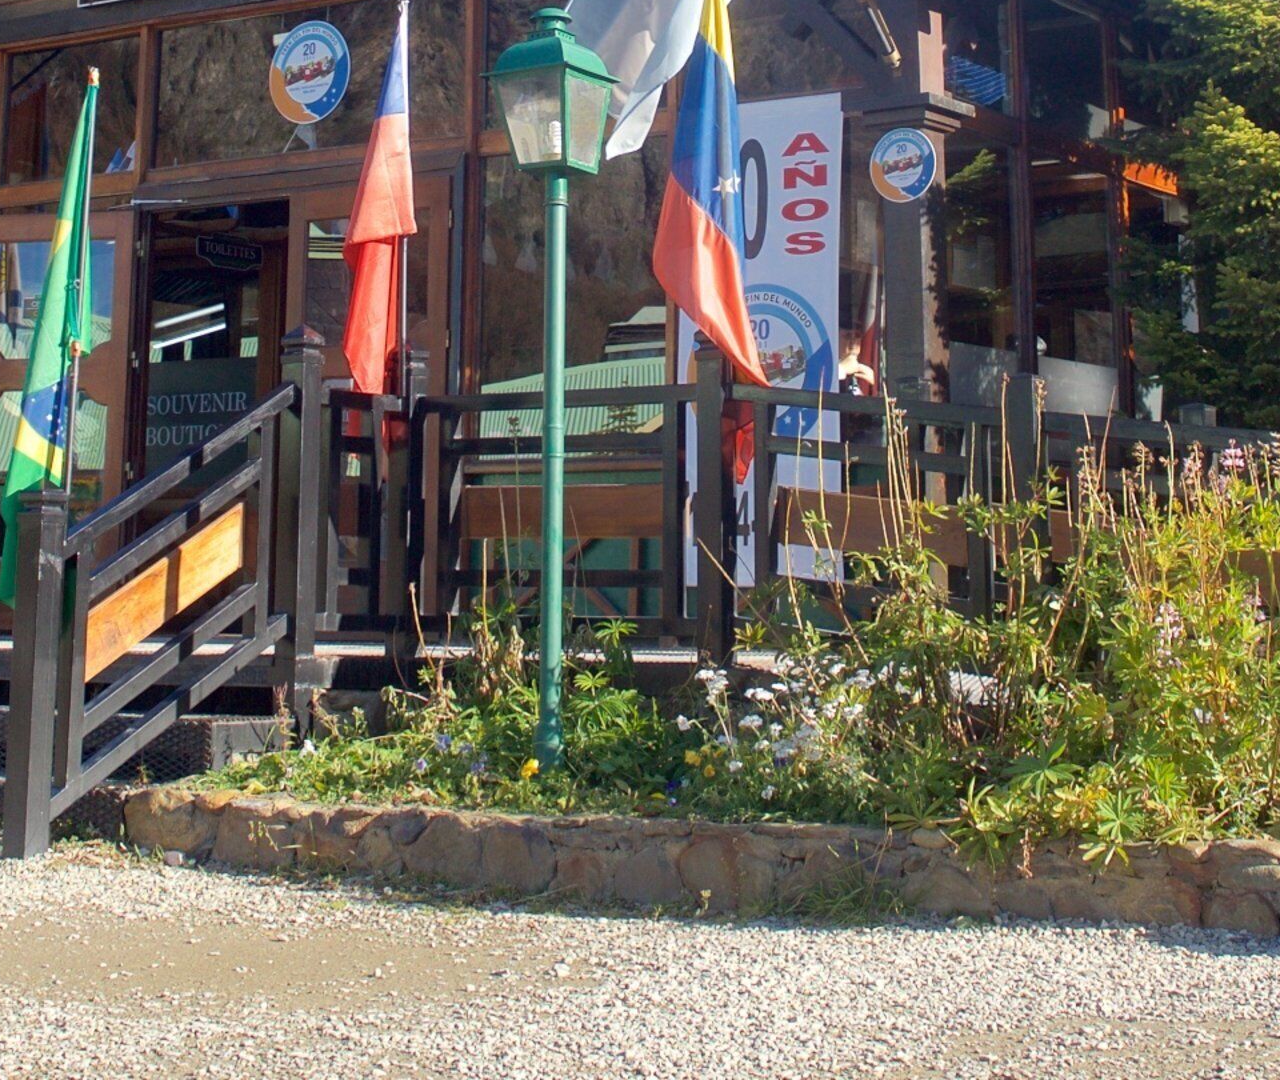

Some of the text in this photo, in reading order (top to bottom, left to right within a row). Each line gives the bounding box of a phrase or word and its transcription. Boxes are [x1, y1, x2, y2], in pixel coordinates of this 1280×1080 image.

[303, 42, 316, 56] 20
[896, 143, 907, 154] 20
[739, 132, 830, 260] 0 AÑOS
[204, 241, 256, 260] TOILETTES
[763, 293, 780, 304] DEL
[782, 298, 812, 329] MUNDO
[147, 391, 247, 416] SOUVENIR
